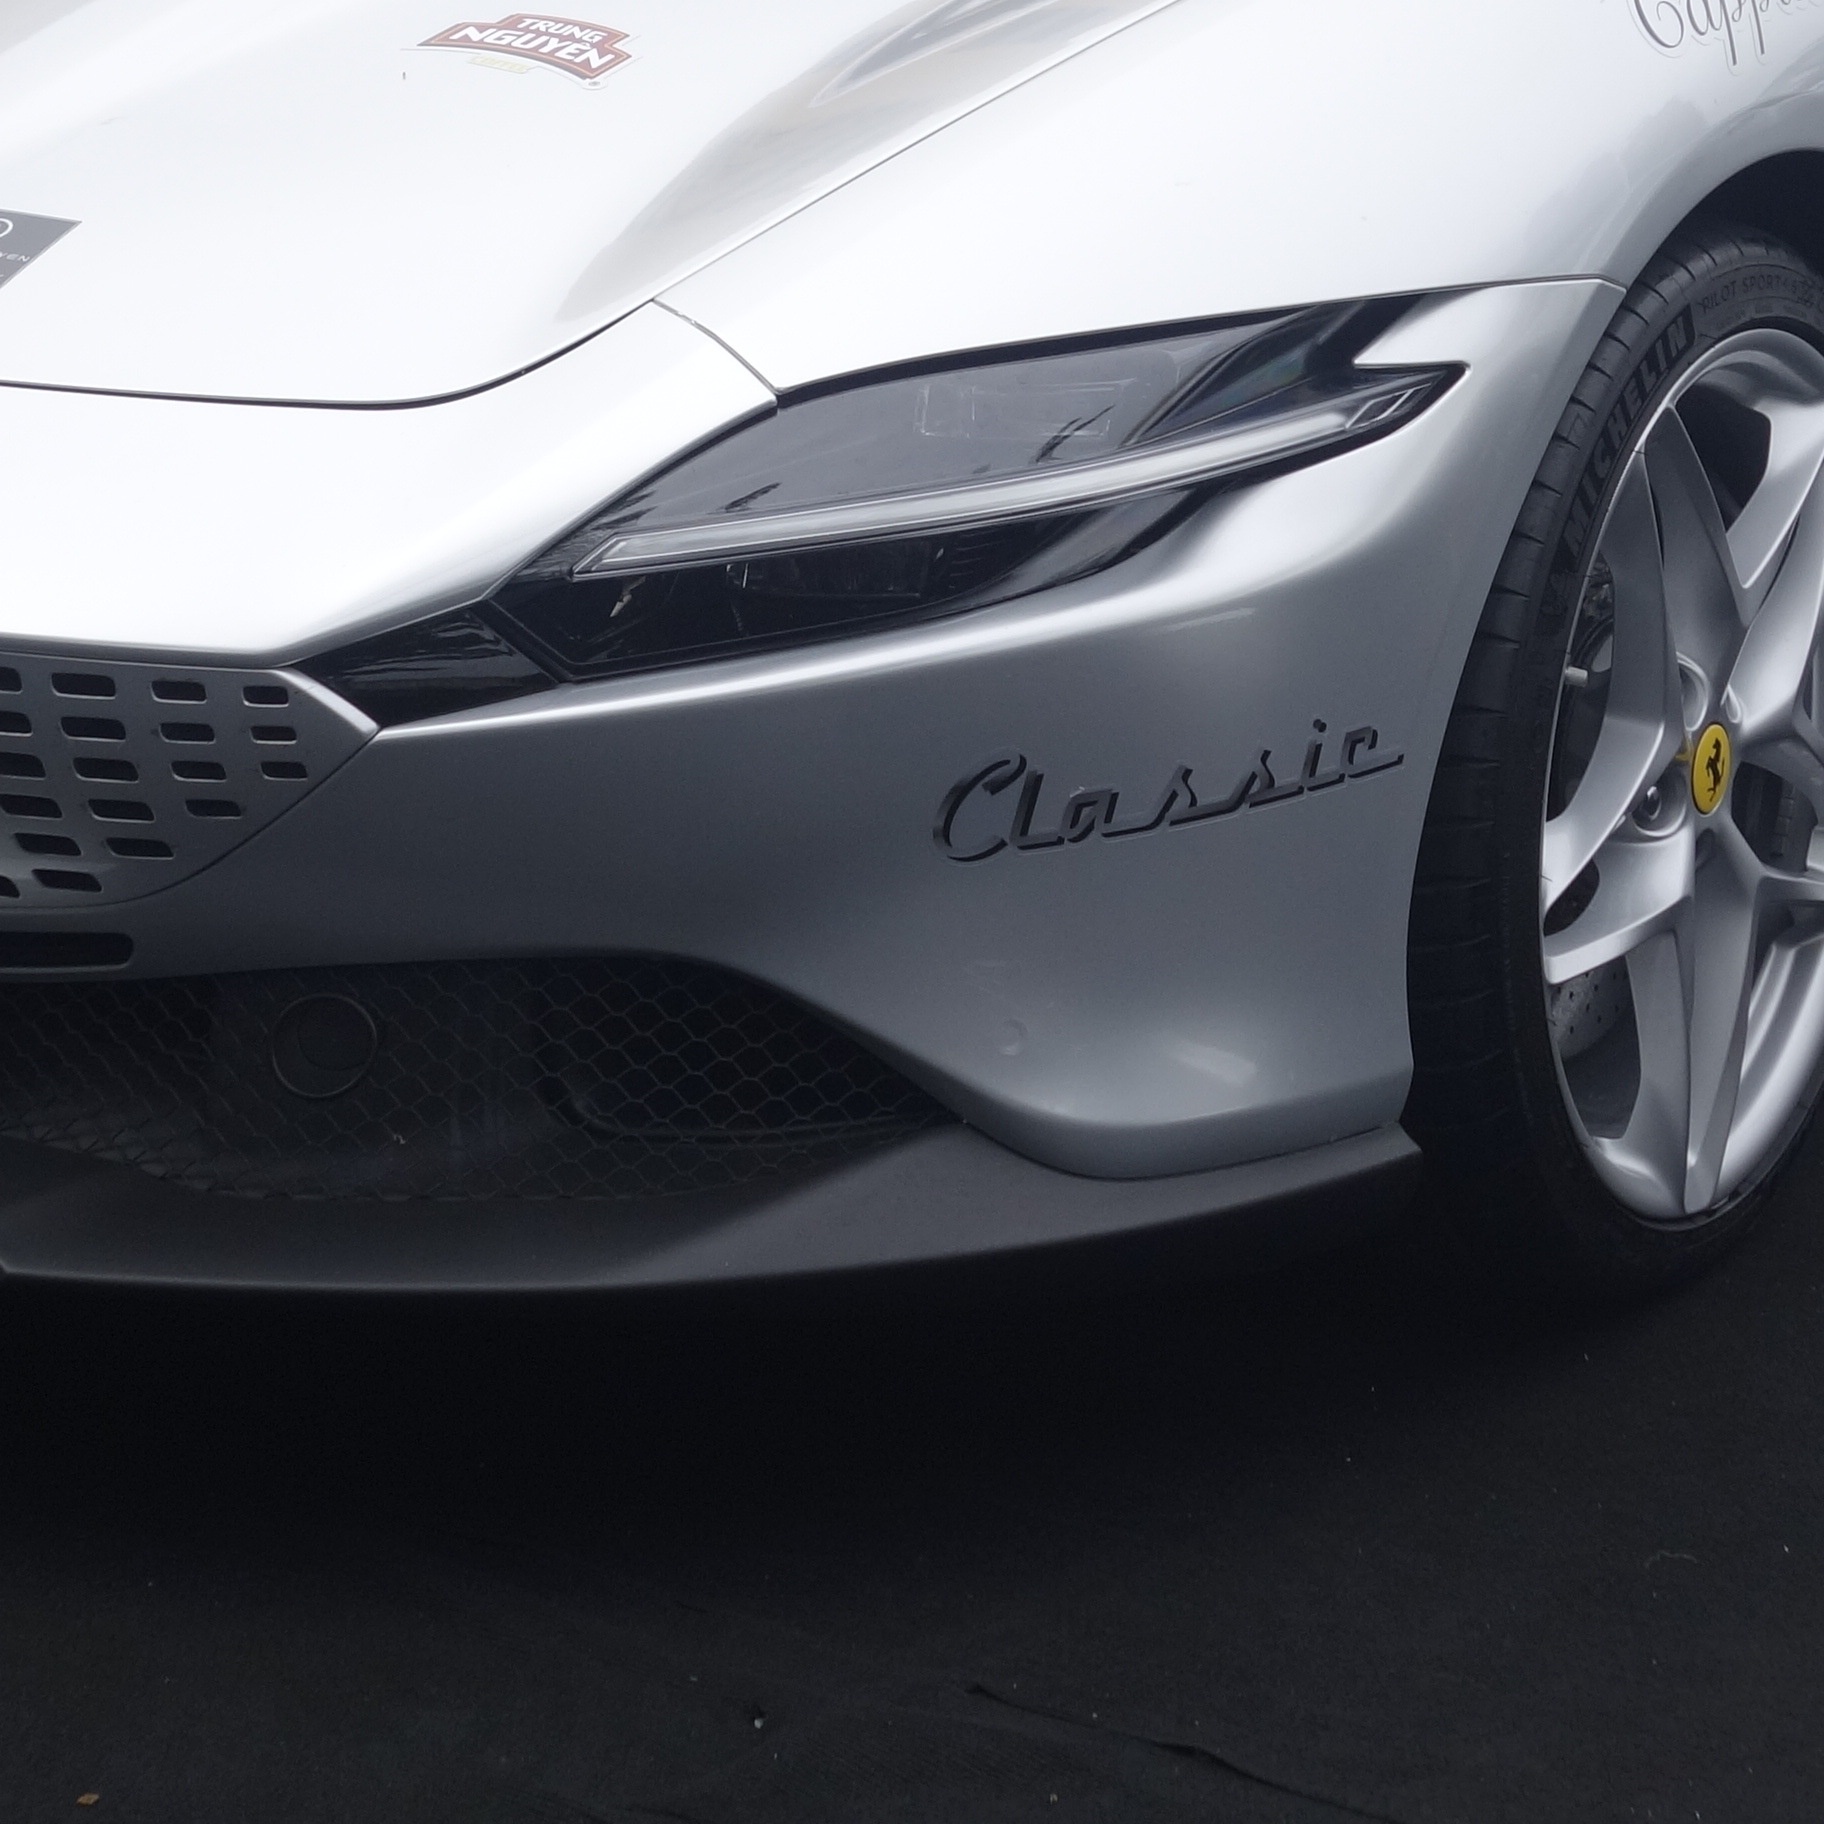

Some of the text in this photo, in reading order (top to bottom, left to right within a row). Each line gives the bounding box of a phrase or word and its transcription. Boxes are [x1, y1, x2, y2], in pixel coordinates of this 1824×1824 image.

[448, 25, 616, 69] NGUYÊN
[516, 17, 611, 45] TRUNG
[932, 718, 1405, 864] Classic
